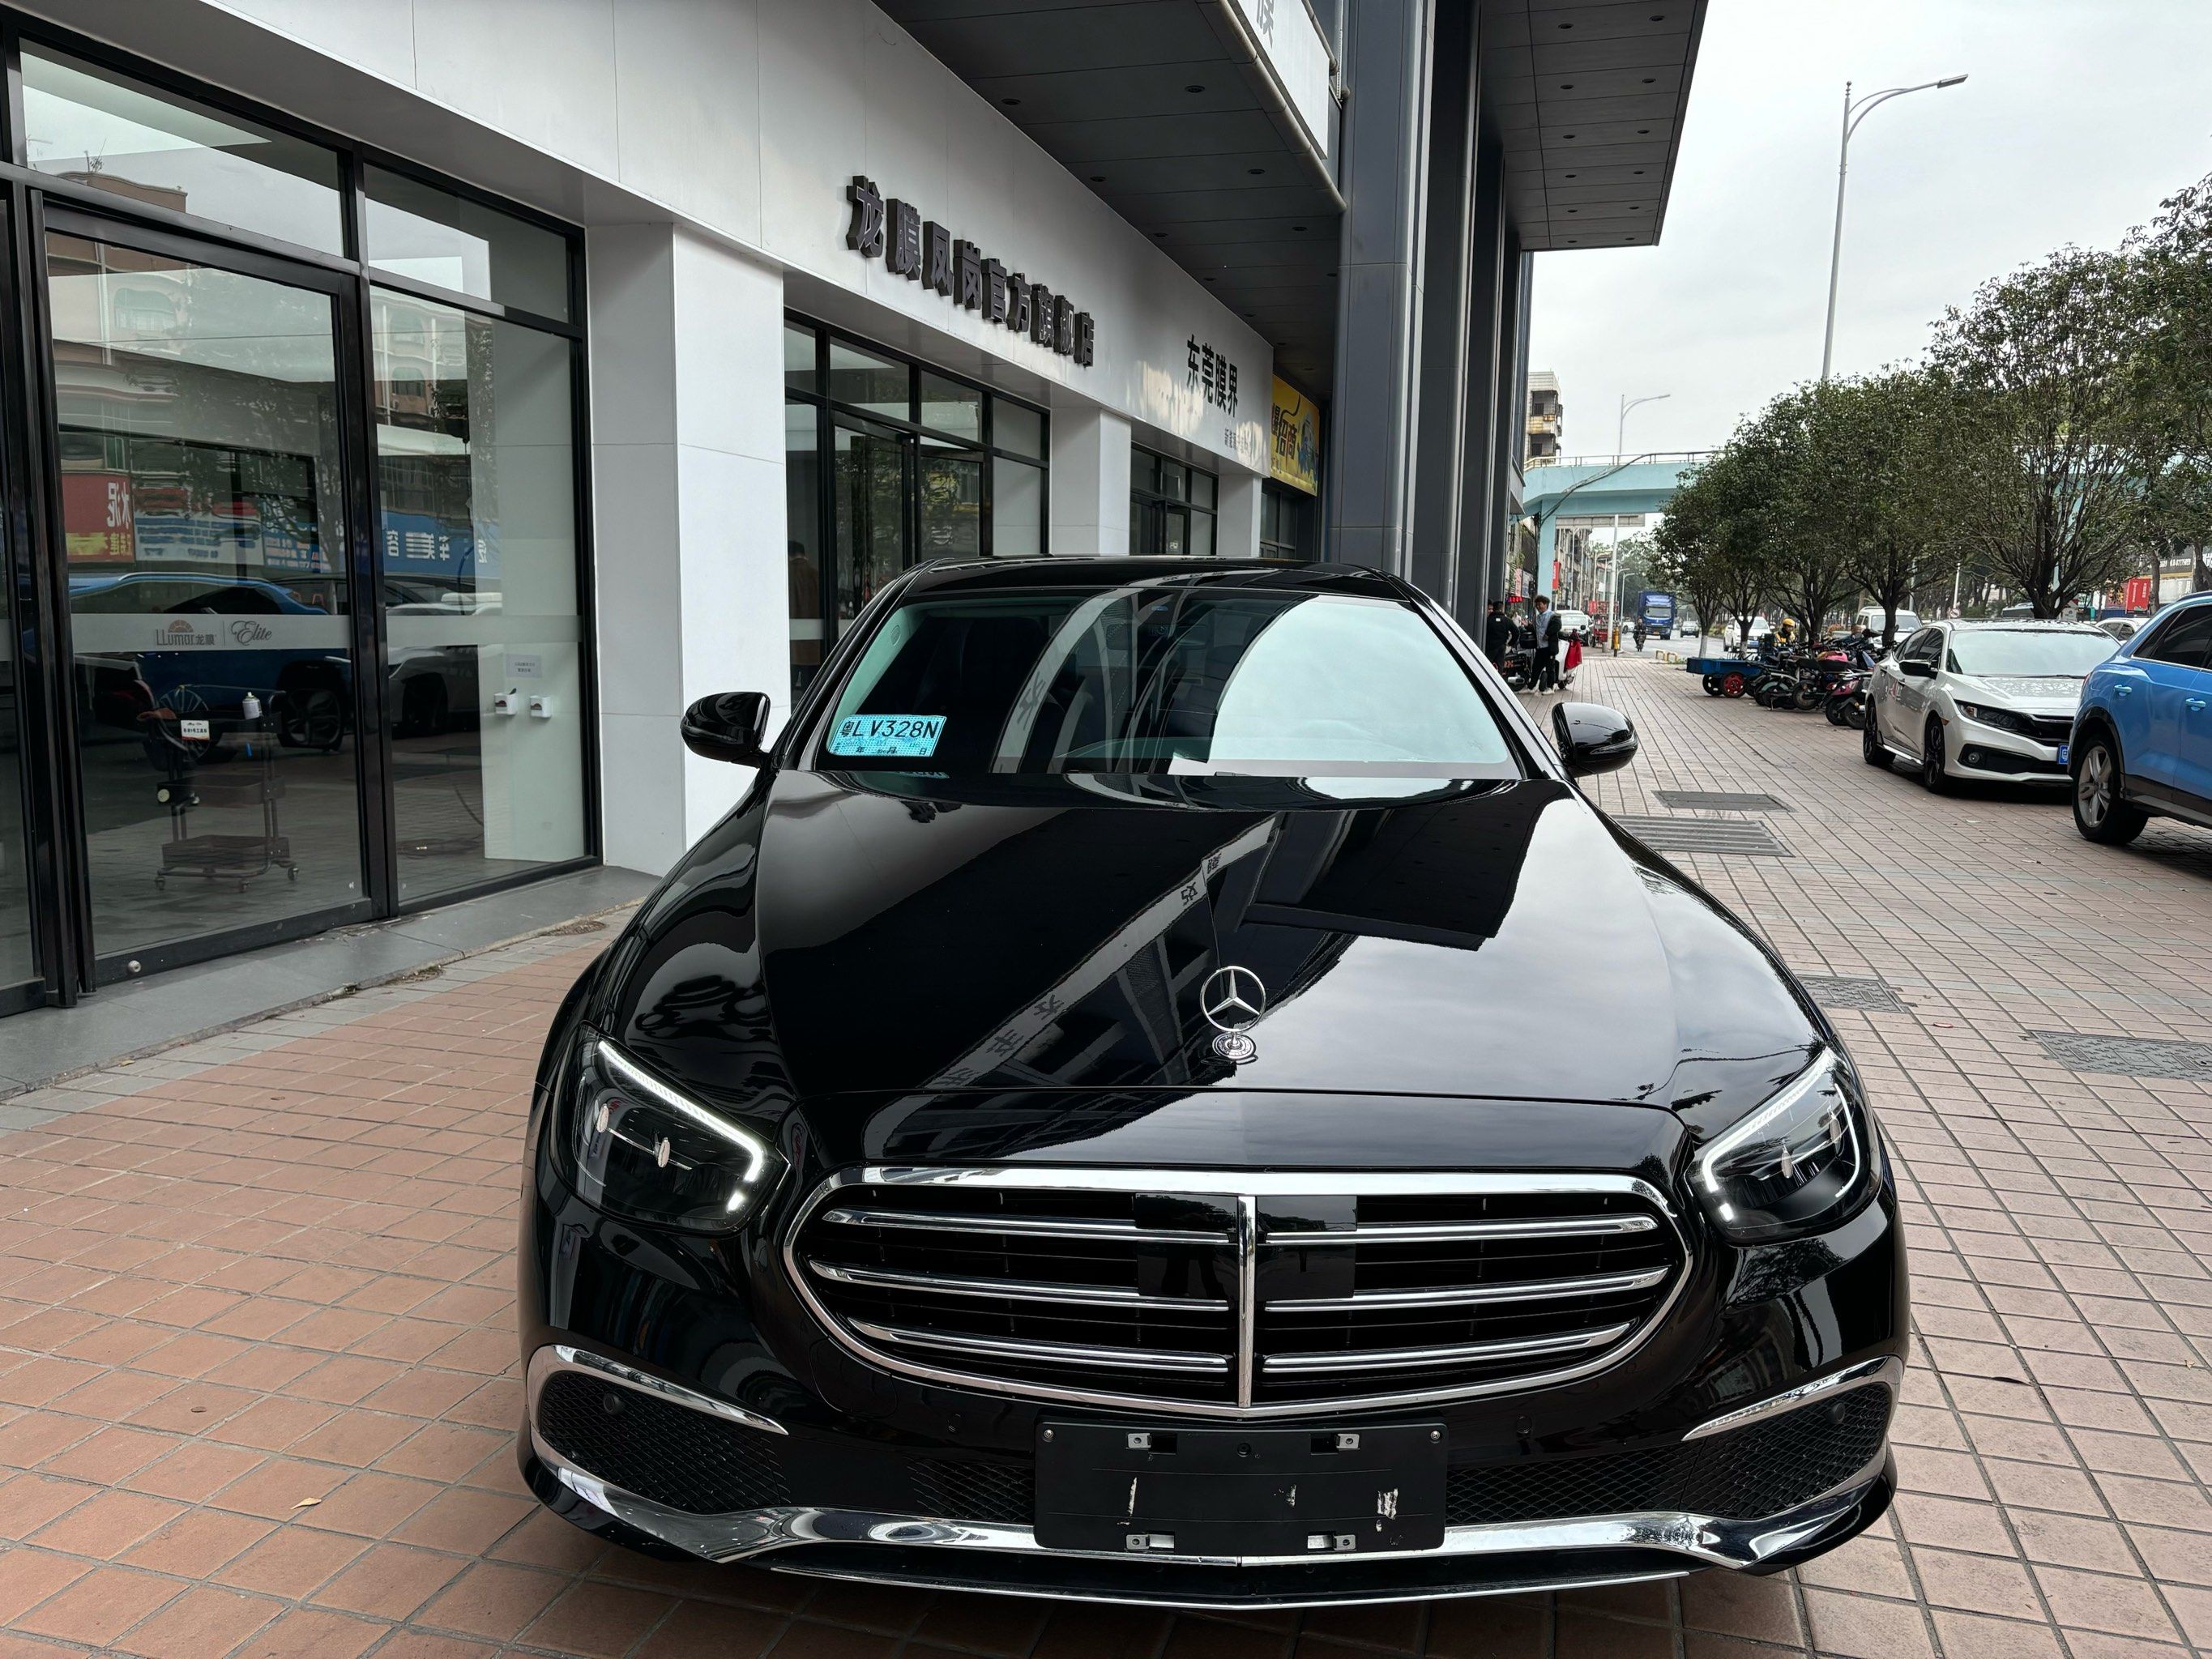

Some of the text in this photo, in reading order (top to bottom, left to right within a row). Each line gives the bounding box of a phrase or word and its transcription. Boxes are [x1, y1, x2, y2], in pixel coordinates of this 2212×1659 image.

[847, 175, 1094, 367] 龙膜凤岗官方旗舰店
[1187, 334, 1238, 418] 东莞膜界
[231, 621, 272, 646] Elite
